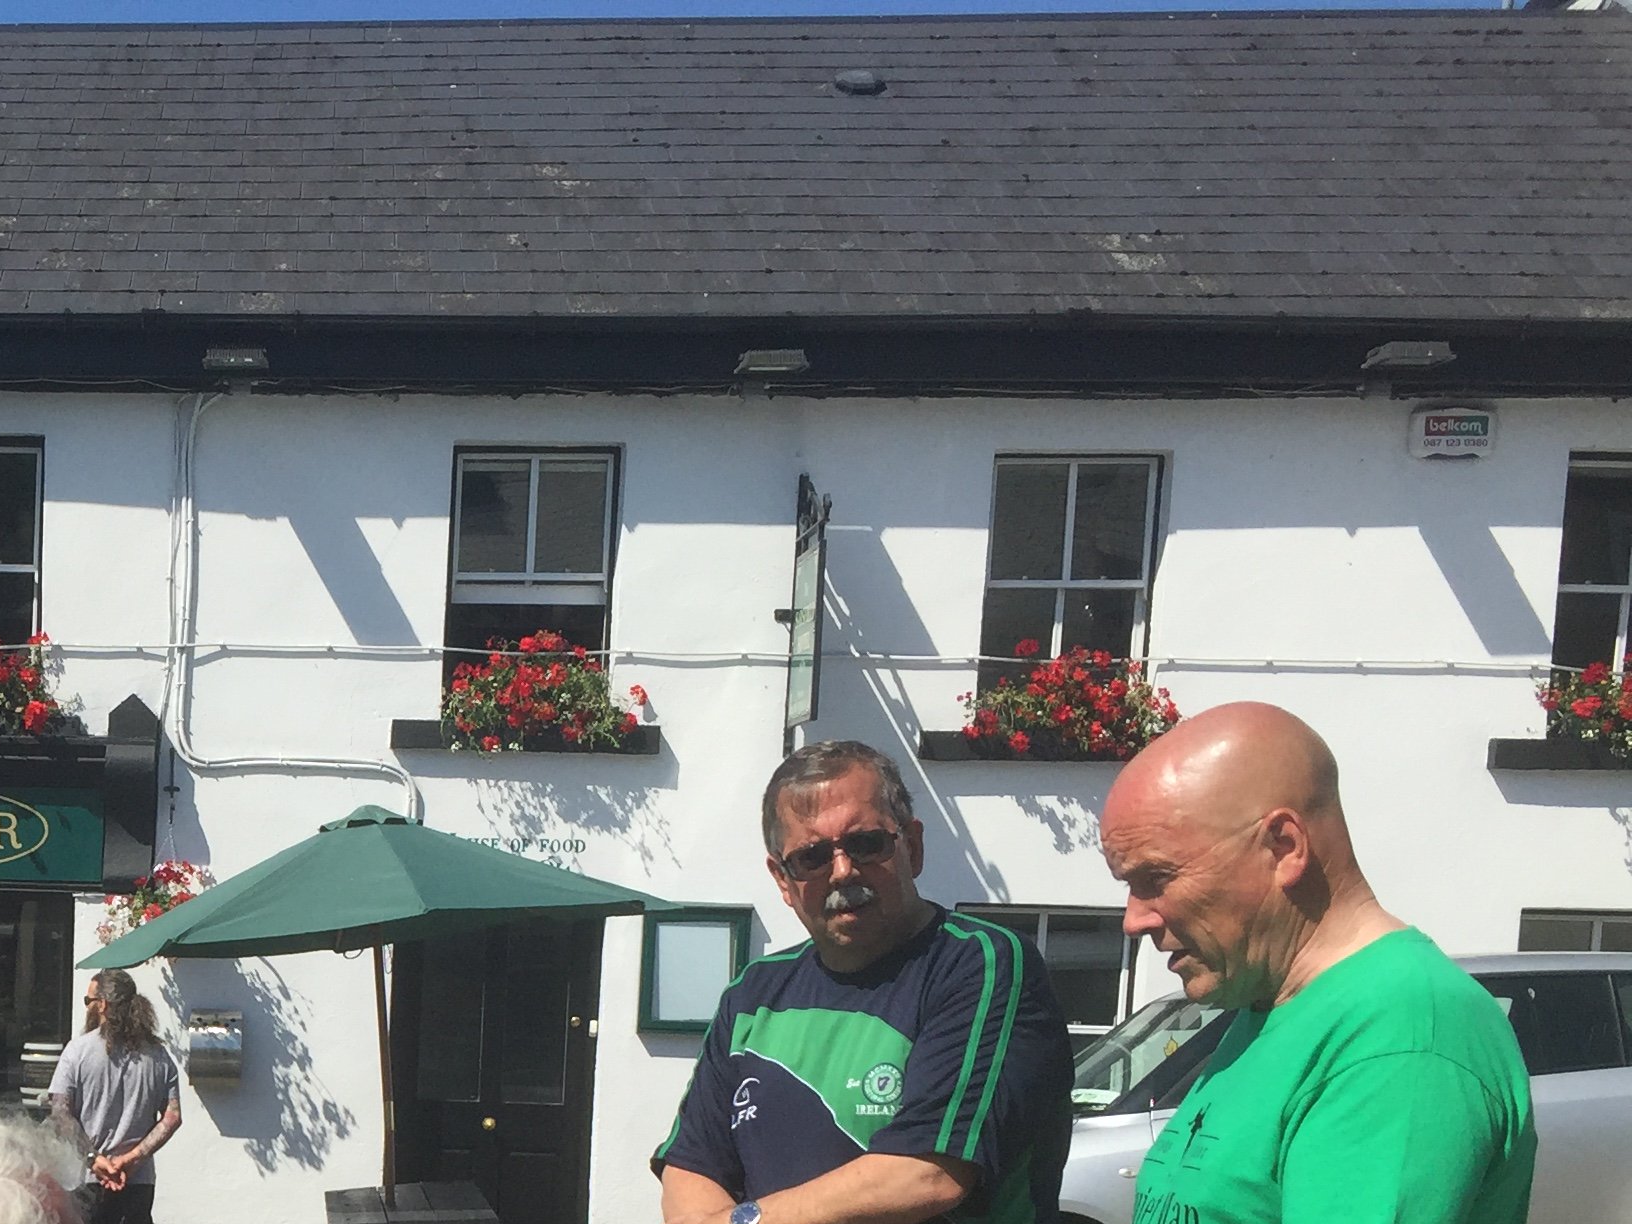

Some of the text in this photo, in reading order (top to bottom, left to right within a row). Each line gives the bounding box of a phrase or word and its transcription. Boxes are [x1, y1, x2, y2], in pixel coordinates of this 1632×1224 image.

[1429, 418, 1484, 434] bellcom
[510, 838, 530, 853] OF
[539, 838, 586, 853] FOOD
[855, 1104, 903, 1115] IRELAN
